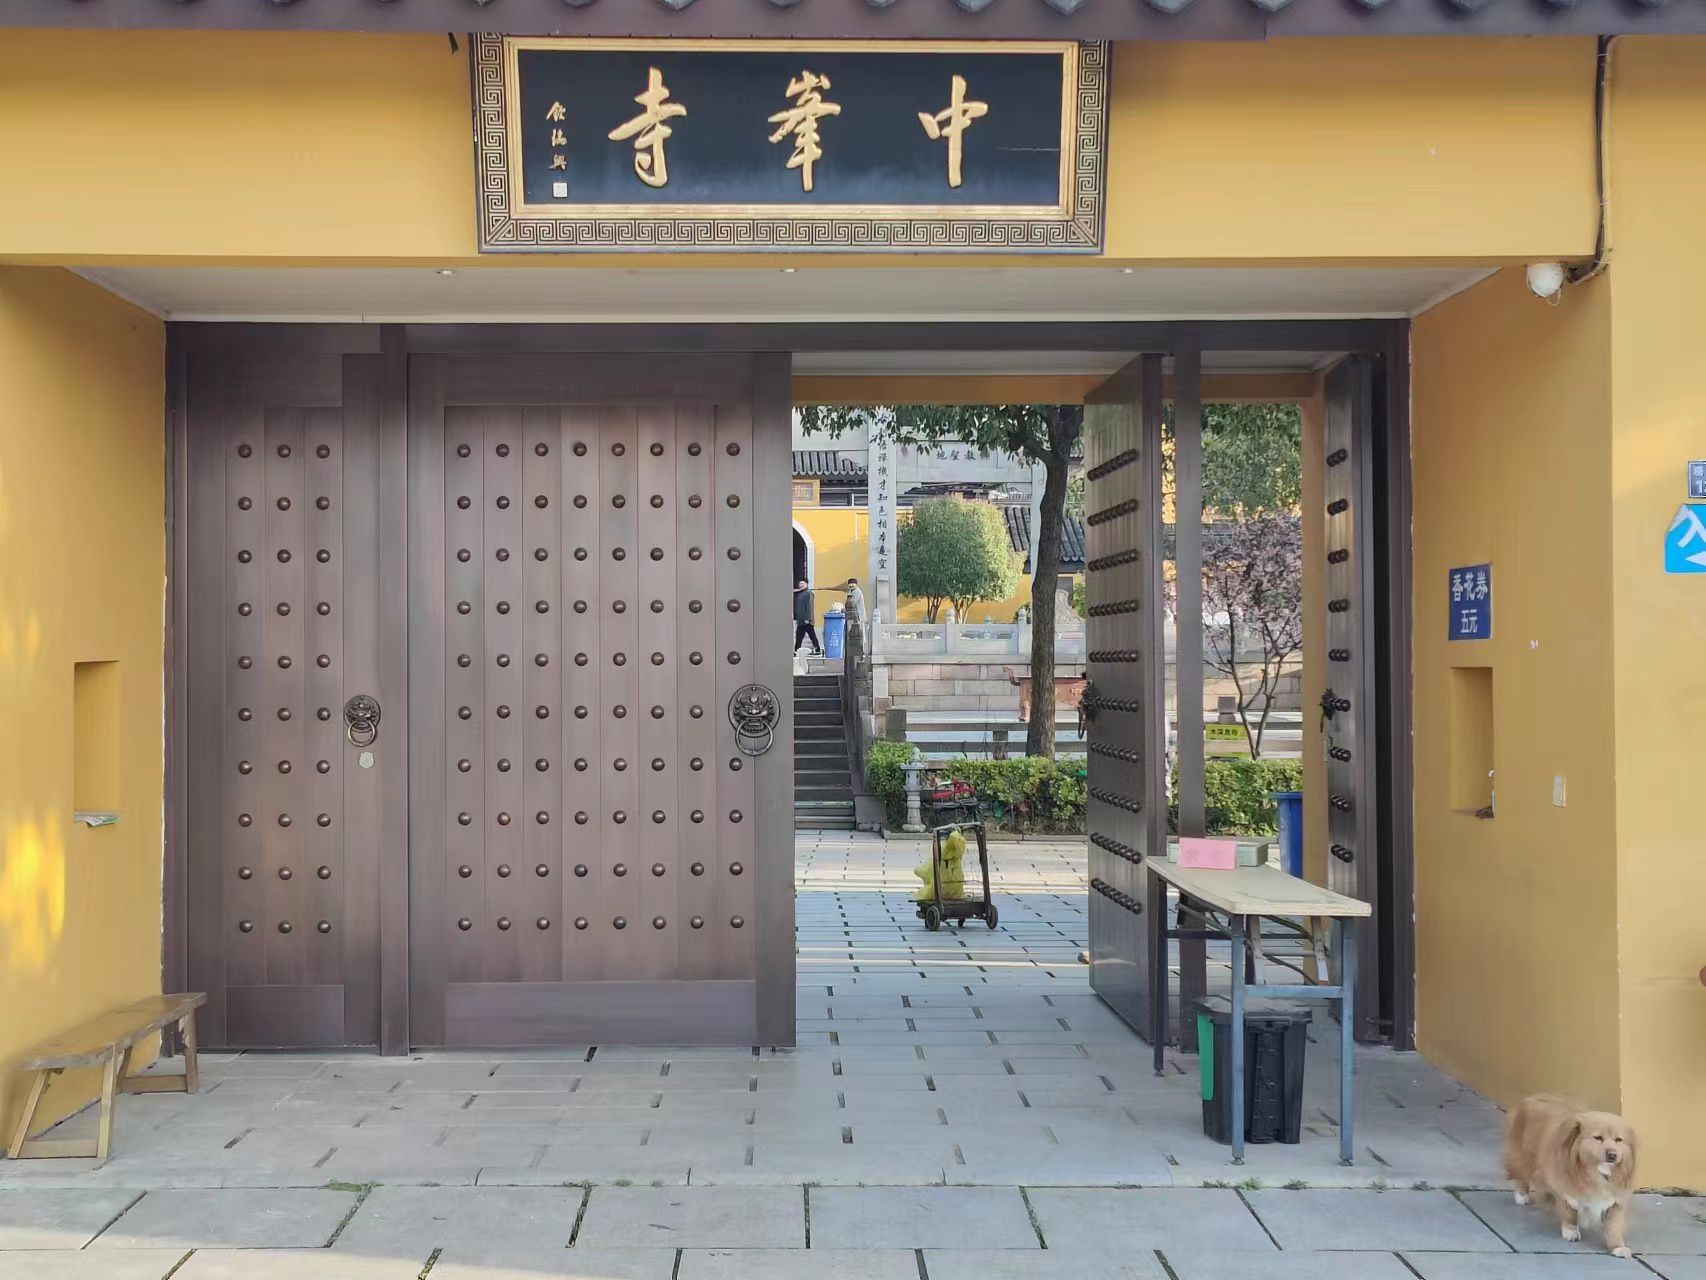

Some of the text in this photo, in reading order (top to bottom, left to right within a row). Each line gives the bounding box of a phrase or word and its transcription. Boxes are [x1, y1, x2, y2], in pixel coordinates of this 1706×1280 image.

[1452, 570, 1489, 602] 香花券
[1460, 608, 1478, 633] 五元
